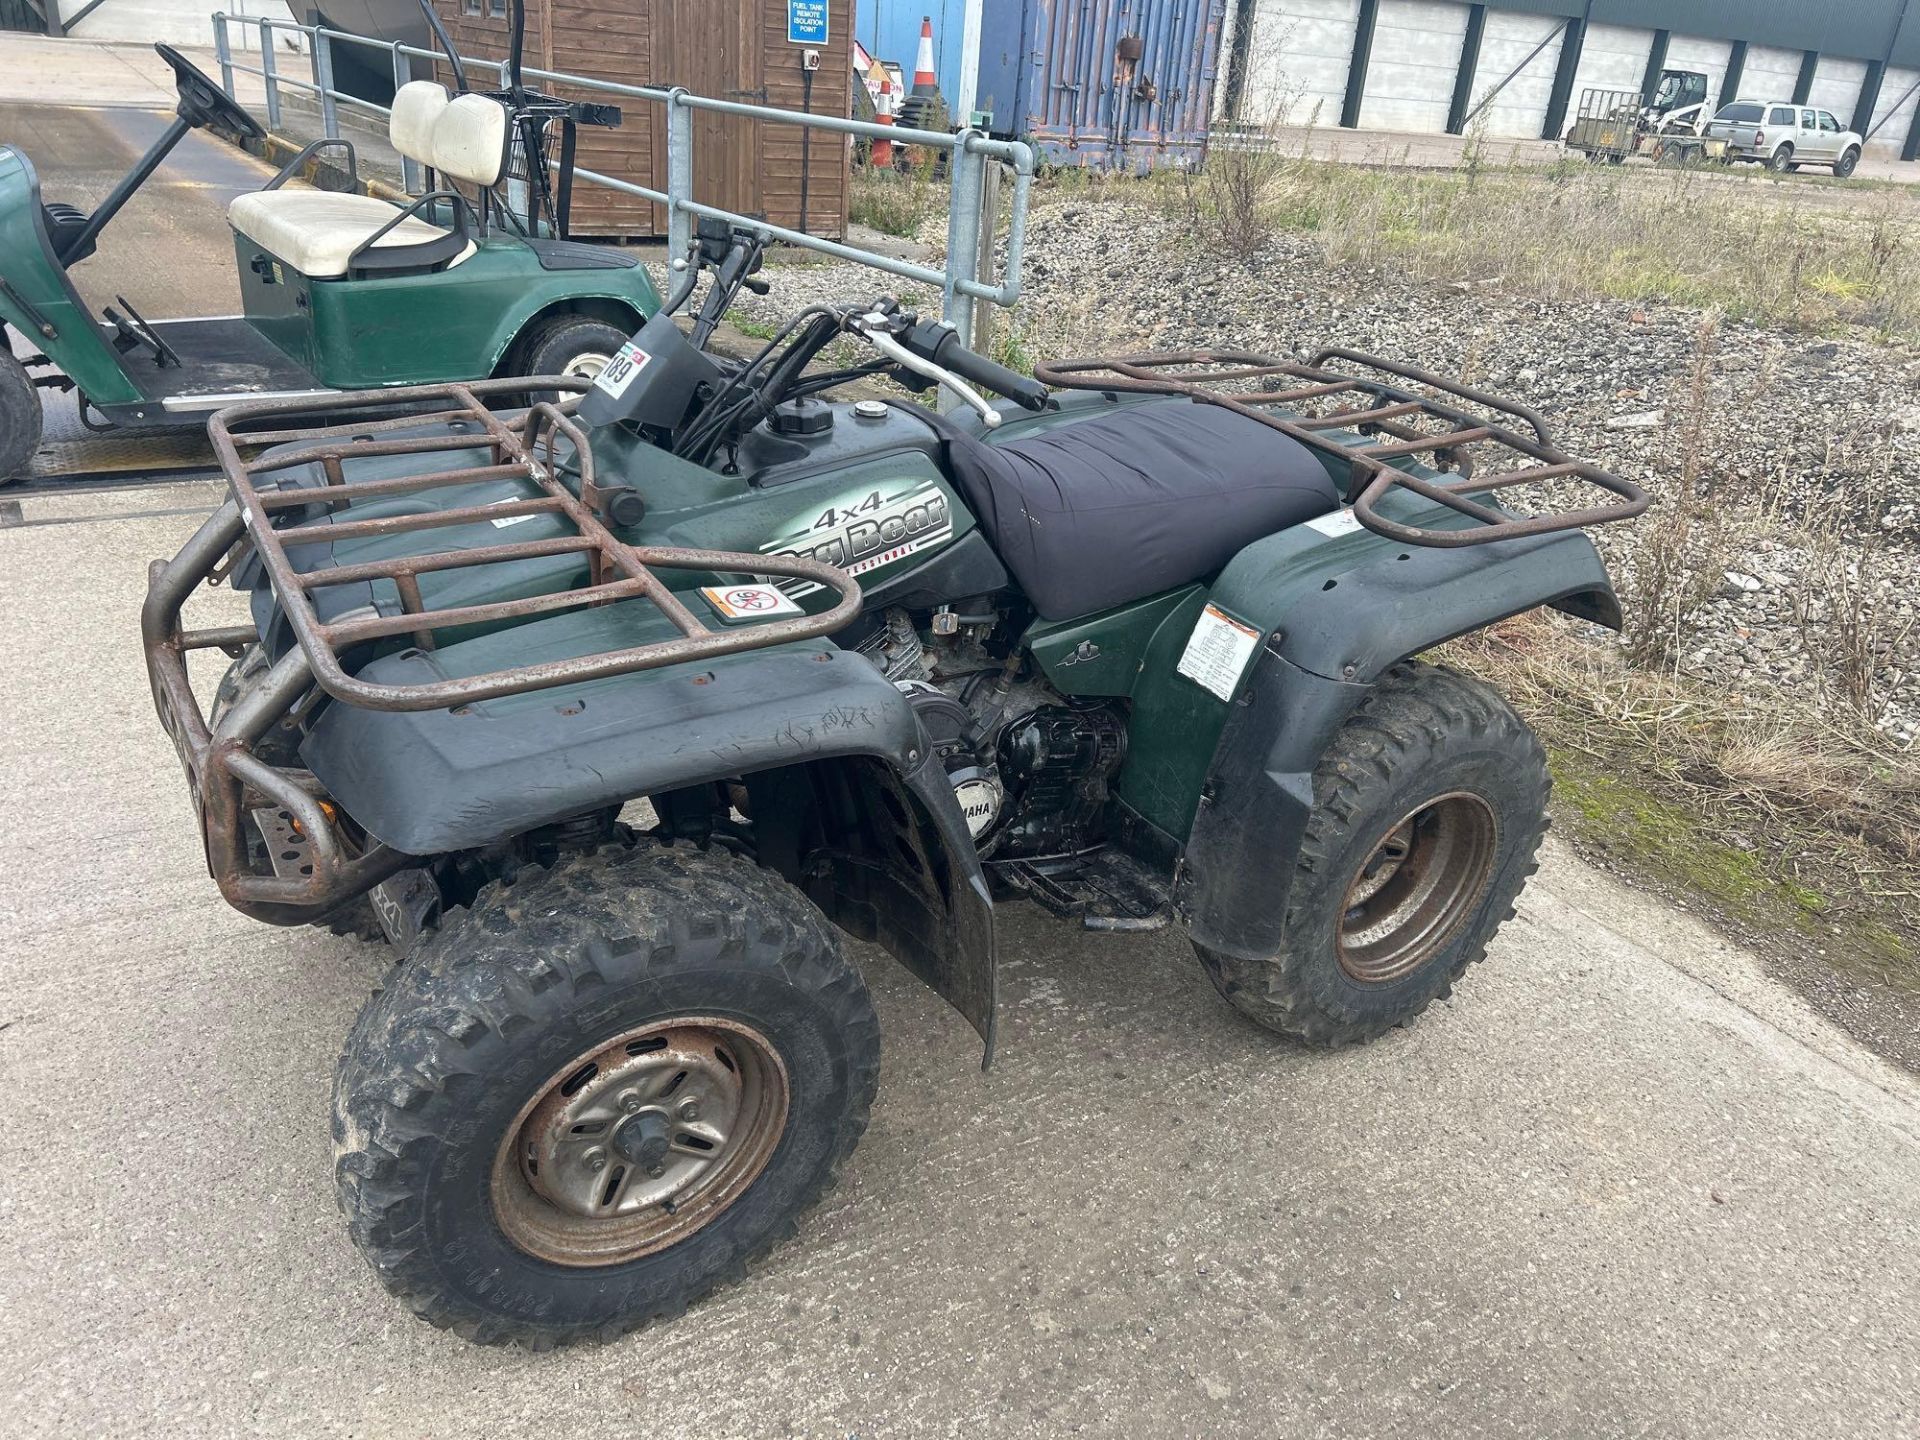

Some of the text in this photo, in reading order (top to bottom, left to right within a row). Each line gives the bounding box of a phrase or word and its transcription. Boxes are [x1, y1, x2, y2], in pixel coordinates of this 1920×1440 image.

[794, 17, 823, 26] ISOLATION
[796, 10, 820, 18] REMOTE
[800, 25, 817, 33] POINT
[864, 79, 902, 92] AUON
[604, 355, 633, 383] 189
[813, 491, 883, 528] 4x4
[846, 495, 944, 558] Bear
[846, 544, 913, 574] FESSIONAL
[964, 803, 989, 818] AHA
